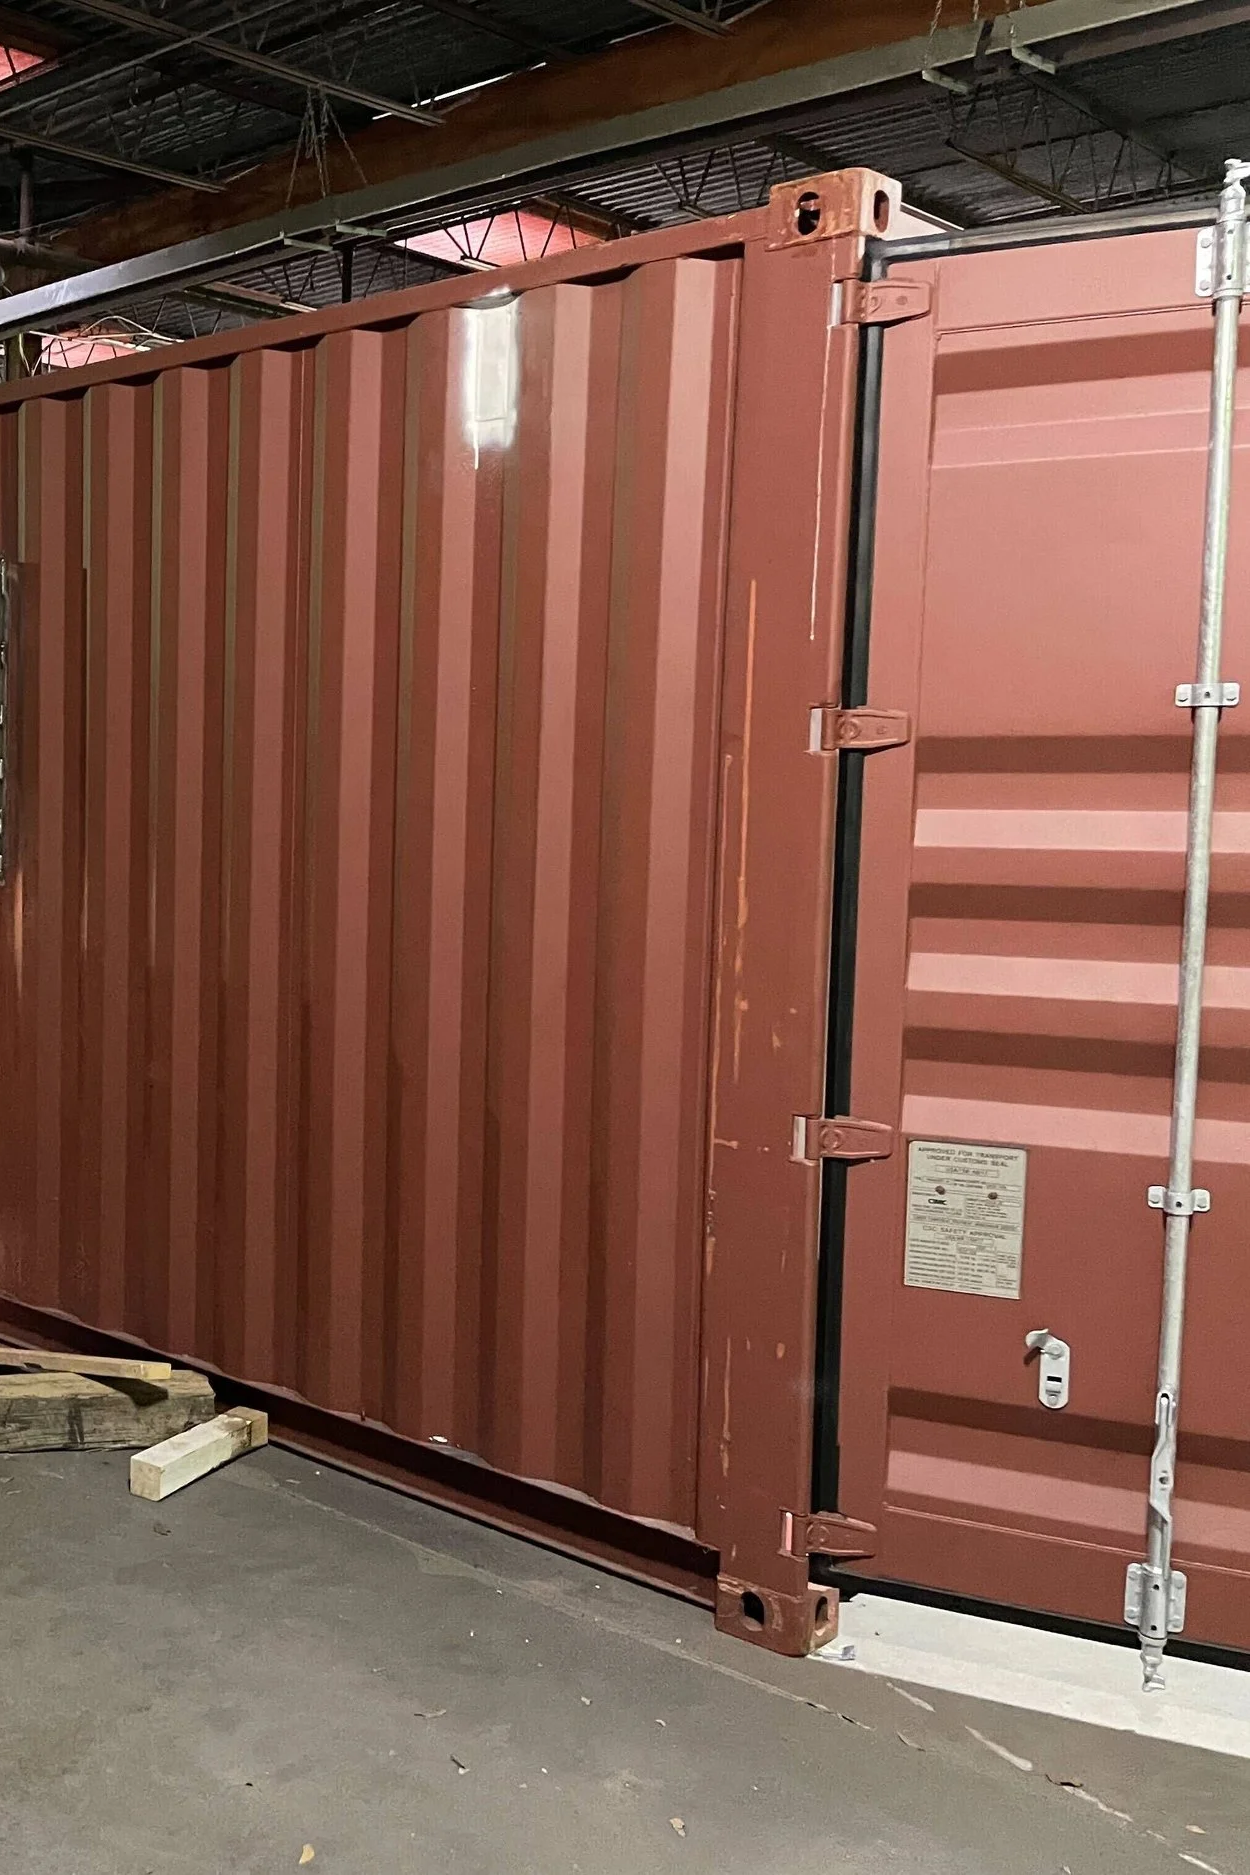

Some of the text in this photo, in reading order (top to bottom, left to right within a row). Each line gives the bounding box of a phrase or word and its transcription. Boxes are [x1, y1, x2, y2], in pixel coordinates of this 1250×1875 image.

[918, 1147, 956, 1155] APPROVED
[976, 1152, 1019, 1161] TRANSPORT
[926, 1154, 1009, 1168] UNDER CUSTOMS SEAL
[940, 1227, 967, 1235] SAFETY
[969, 1231, 1007, 1240] APPROVAL
